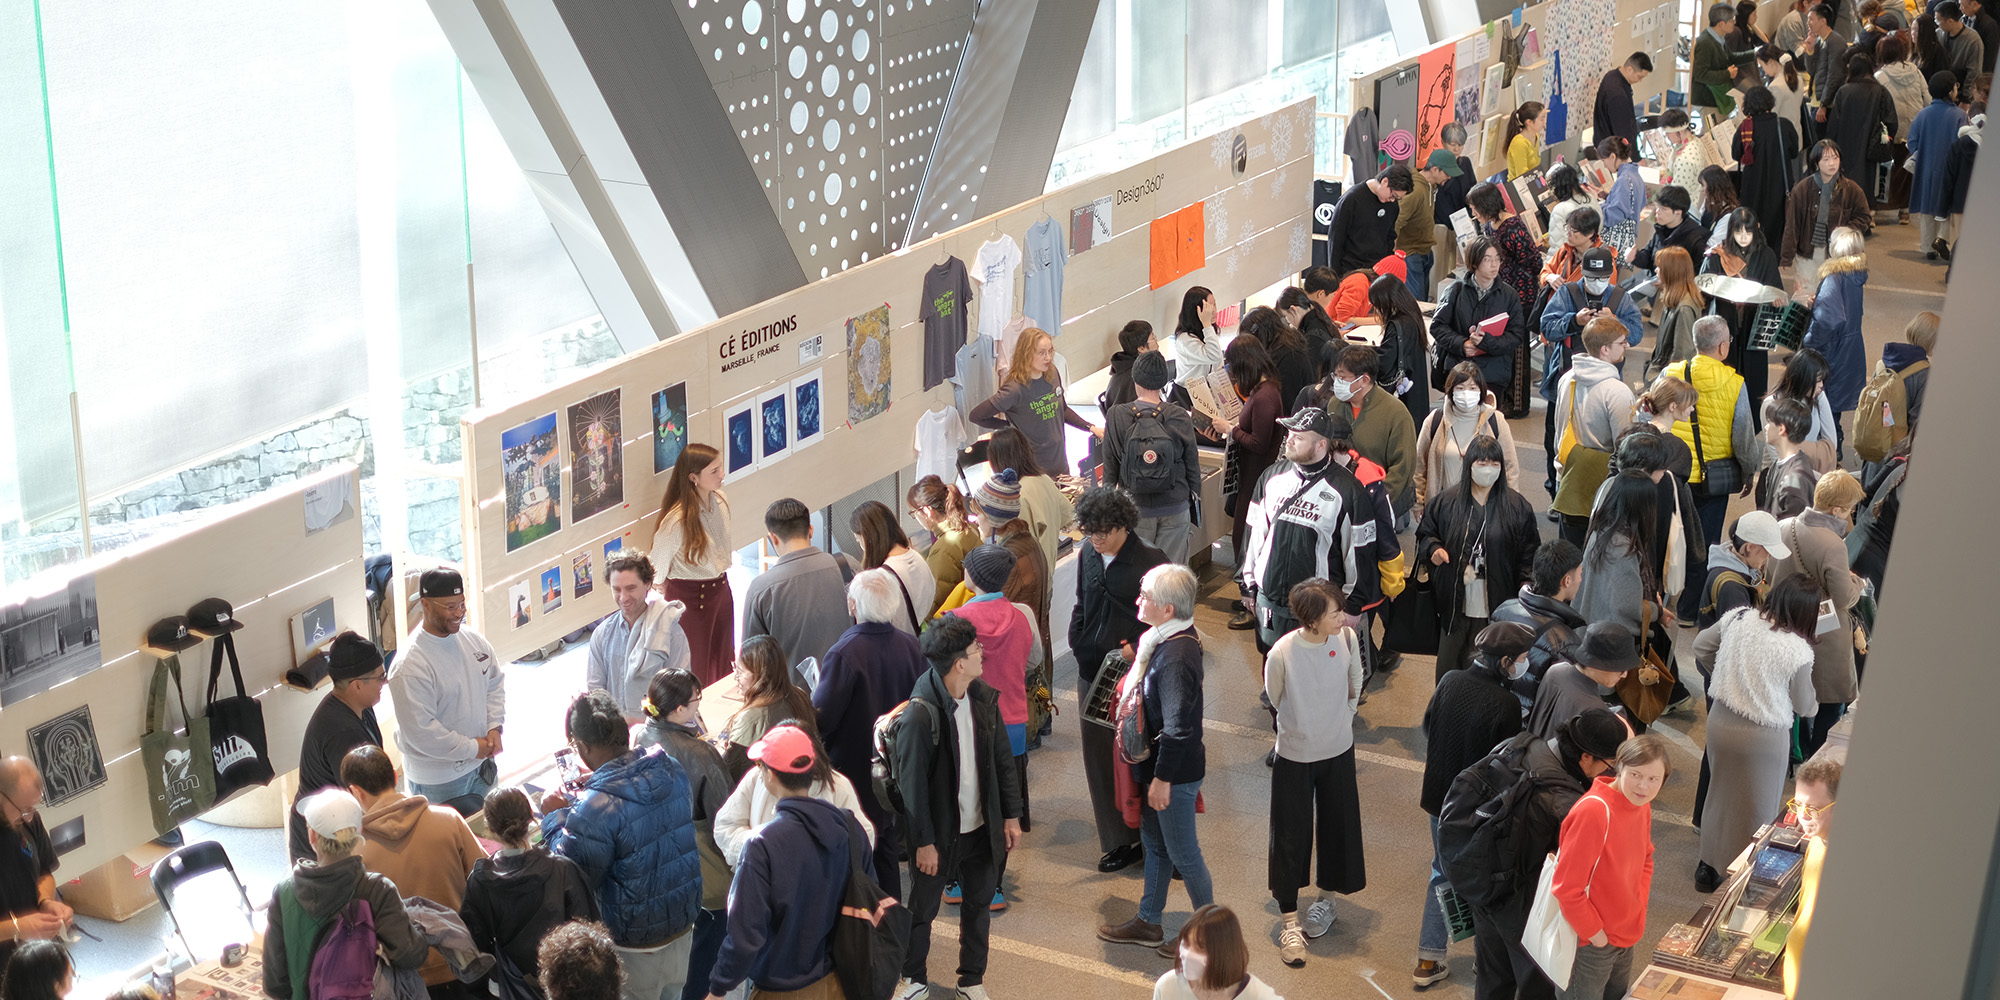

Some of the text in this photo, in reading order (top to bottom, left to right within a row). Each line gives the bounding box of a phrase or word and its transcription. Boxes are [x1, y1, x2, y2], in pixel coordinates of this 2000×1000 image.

[1116, 173, 1165, 206] Design360°
[720, 315, 798, 359] CÉ ÉDITIONS
[721, 343, 780, 374] MARSEILLE, FRANCE
[1029, 400, 1045, 410] the
[1036, 400, 1059, 415] angry
[1042, 409, 1056, 421] bat
